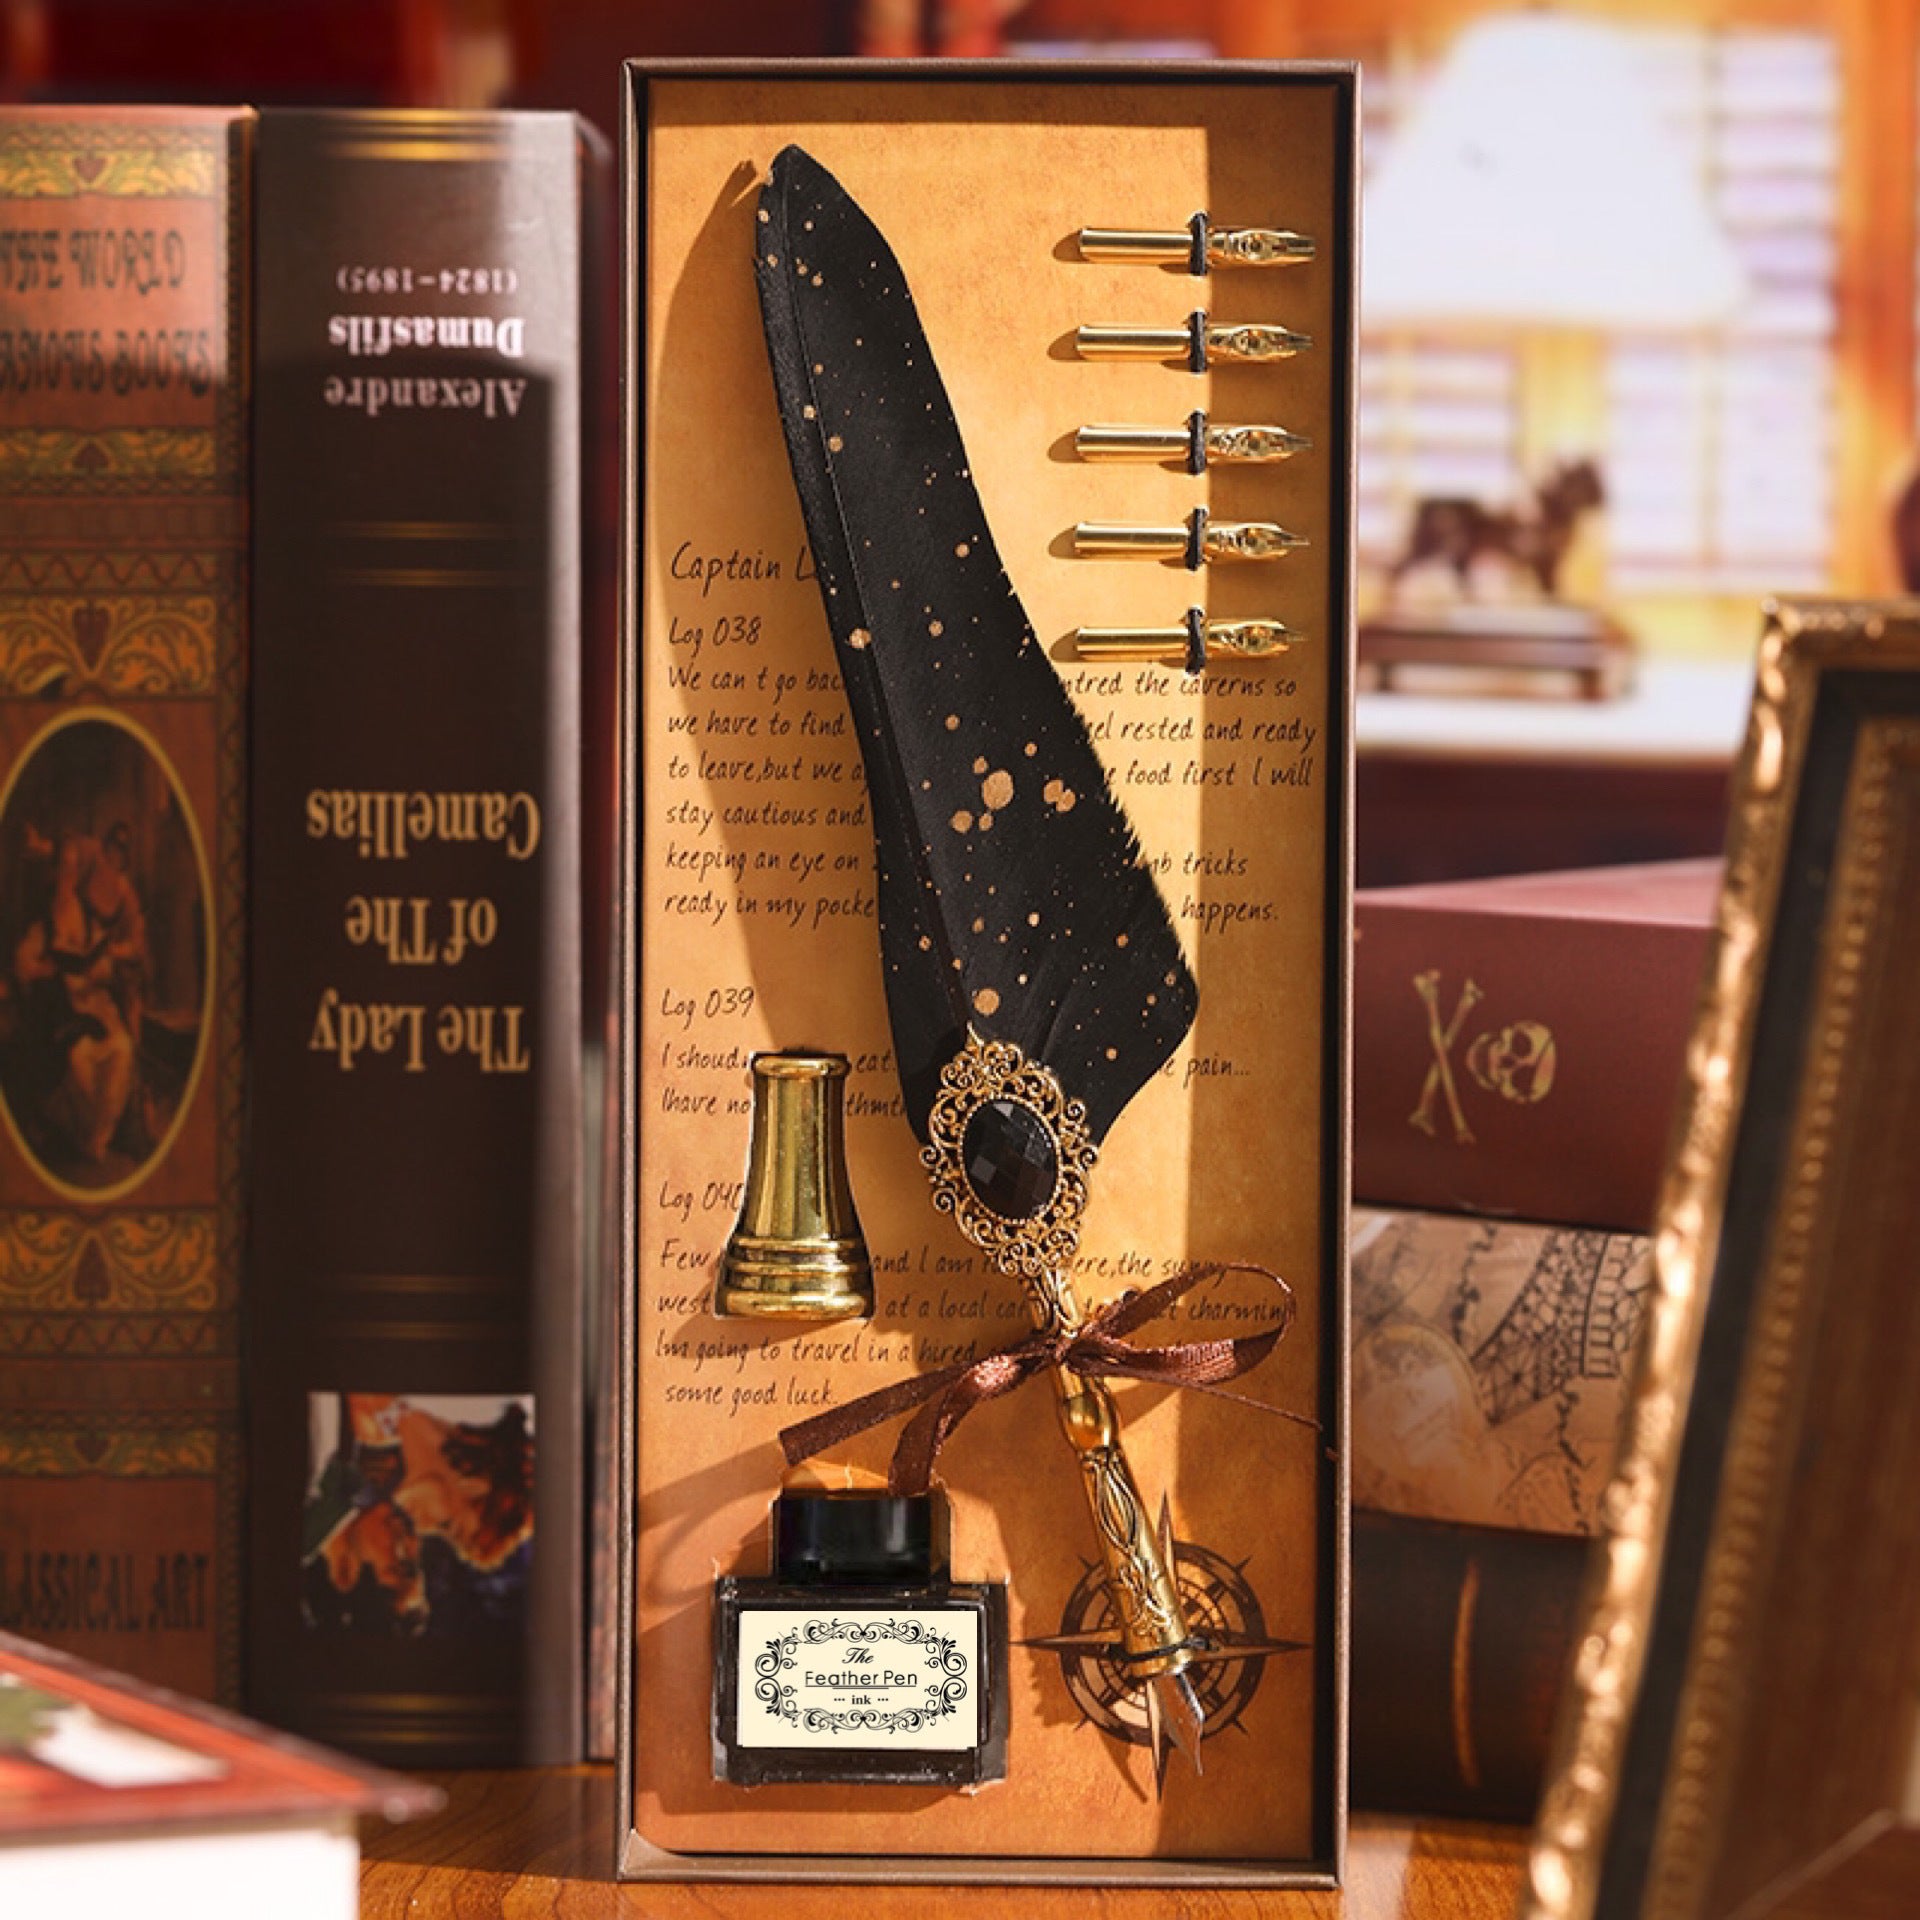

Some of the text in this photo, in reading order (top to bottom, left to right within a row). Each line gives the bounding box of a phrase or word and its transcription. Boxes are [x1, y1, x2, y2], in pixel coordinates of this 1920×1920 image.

[328, 316, 525, 359] Dumasfils
[323, 376, 527, 418] Alexandre
[672, 541, 780, 597] Captain
[669, 616, 762, 658] Log 038
[669, 662, 701, 691] We
[711, 672, 745, 690] can
[775, 672, 798, 705] go
[1134, 670, 1170, 696] the
[1179, 677, 1266, 696] caverns
[1274, 679, 1297, 696] so
[669, 714, 698, 735] we
[706, 710, 760, 736] have
[769, 711, 791, 735] to
[801, 710, 847, 736] find
[1121, 717, 1194, 742] rested
[1204, 717, 1242, 741] and
[1253, 717, 1317, 754] ready
[669, 756, 690, 780] to
[813, 763, 844, 783] we
[1125, 759, 1172, 786] food
[1183, 760, 1237, 785] first
[1270, 757, 1314, 786] will
[306, 788, 541, 861] Camellias
[667, 801, 867, 836] stay cautious and
[665, 842, 747, 883] keeping
[755, 851, 781, 870] an
[789, 852, 825, 883] eye
[834, 853, 860, 870] on
[1183, 848, 1248, 876] tricks
[344, 895, 498, 966] of The
[664, 891, 727, 926] ready
[736, 891, 757, 913] in
[767, 897, 805, 927] my
[1181, 894, 1279, 935] happens.
[309, 986, 531, 1072] The Lady
[662, 986, 755, 1030] Log 039
[660, 1180, 694, 1224] Log
[661, 1238, 711, 1269] Few
[936, 1254, 974, 1273] am
[657, 1290, 712, 1313] west
[885, 1294, 911, 1318] at
[918, 1302, 931, 1318] a
[937, 1287, 989, 1319] local
[696, 1335, 751, 1374] going
[760, 1336, 781, 1362] to
[792, 1331, 862, 1363] travel
[868, 1338, 890, 1362] in
[899, 1345, 911, 1362] a
[918, 1337, 980, 1363] hired
[666, 1383, 724, 1405] some
[729, 1380, 777, 1418] good
[842, 1647, 874, 1664] The
[805, 1671, 918, 1686] Feather Pen
[851, 1695, 872, 1706] ink
